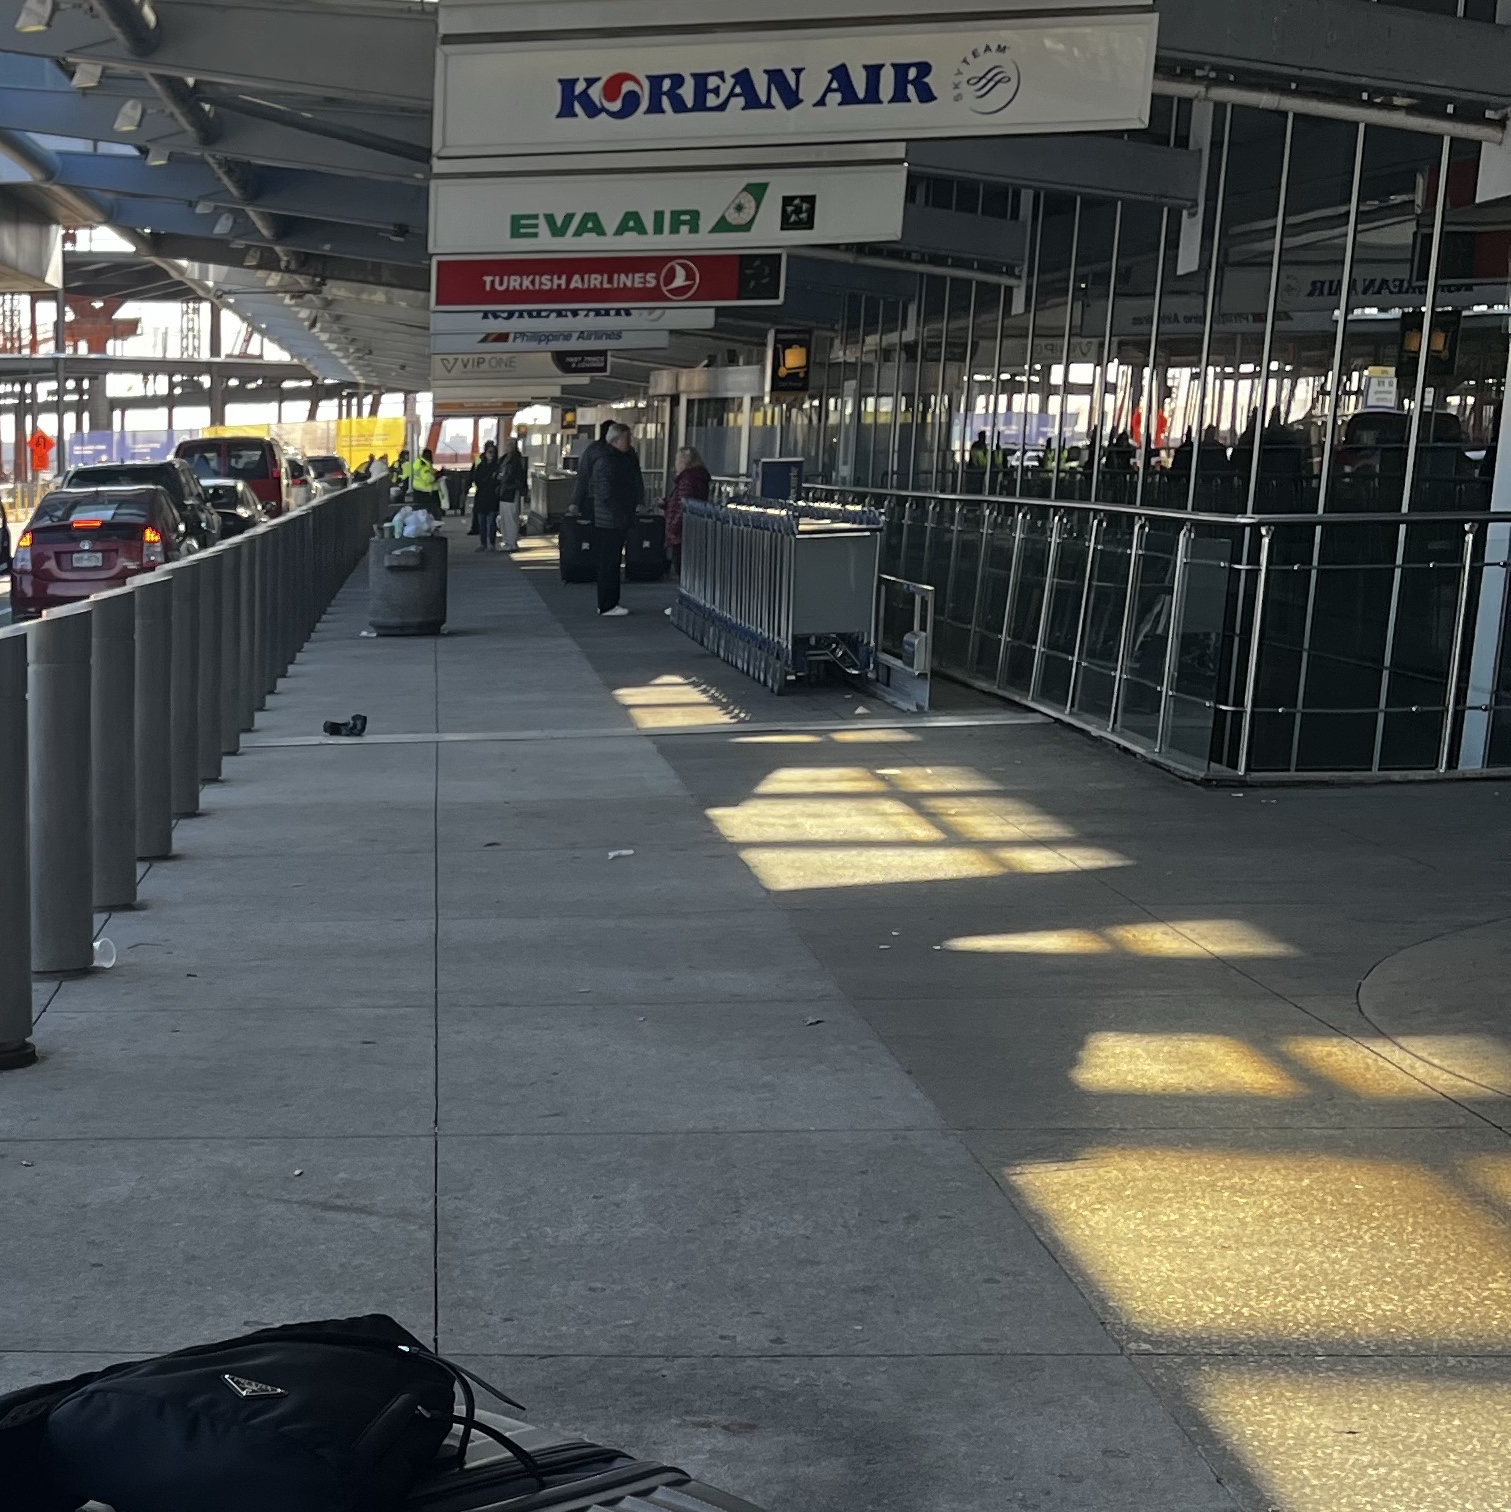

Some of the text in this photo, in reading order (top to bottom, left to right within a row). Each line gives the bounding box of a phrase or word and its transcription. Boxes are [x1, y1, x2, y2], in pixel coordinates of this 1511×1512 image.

[952, 43, 1010, 102] SKYTEAM
[555, 60, 939, 120] KOREAN AIR
[510, 209, 701, 239] EVA AIR
[482, 272, 657, 292] TURKISH AIRLINES
[461, 356, 517, 369] VIP ONE
